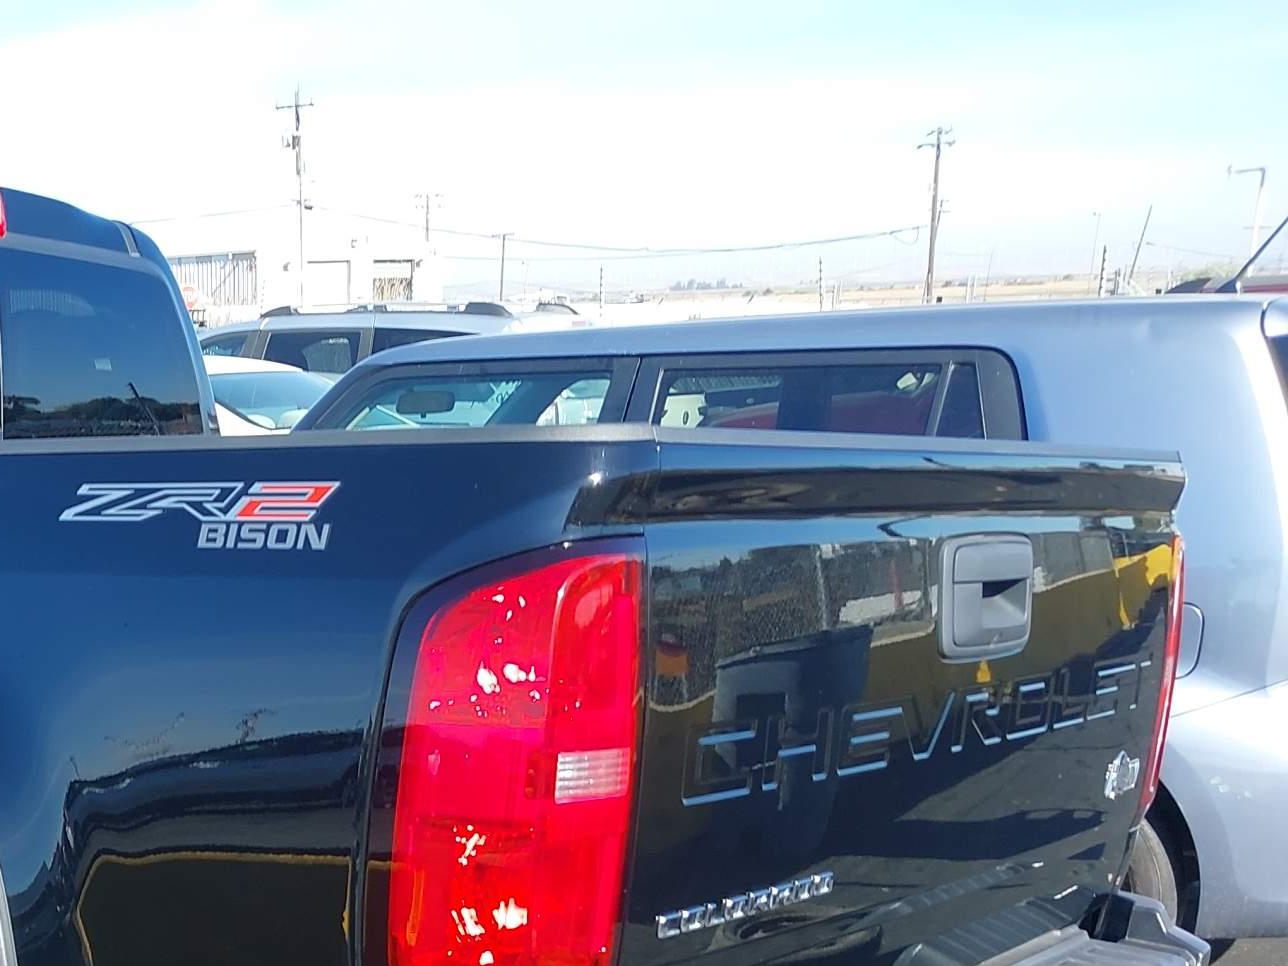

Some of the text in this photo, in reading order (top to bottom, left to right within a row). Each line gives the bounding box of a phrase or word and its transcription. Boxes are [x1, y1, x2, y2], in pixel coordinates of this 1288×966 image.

[59, 481, 341, 521] ZR2
[197, 523, 330, 550] BISON
[681, 652, 1152, 806] CHEVROLET
[656, 871, 834, 940] COLORADO
